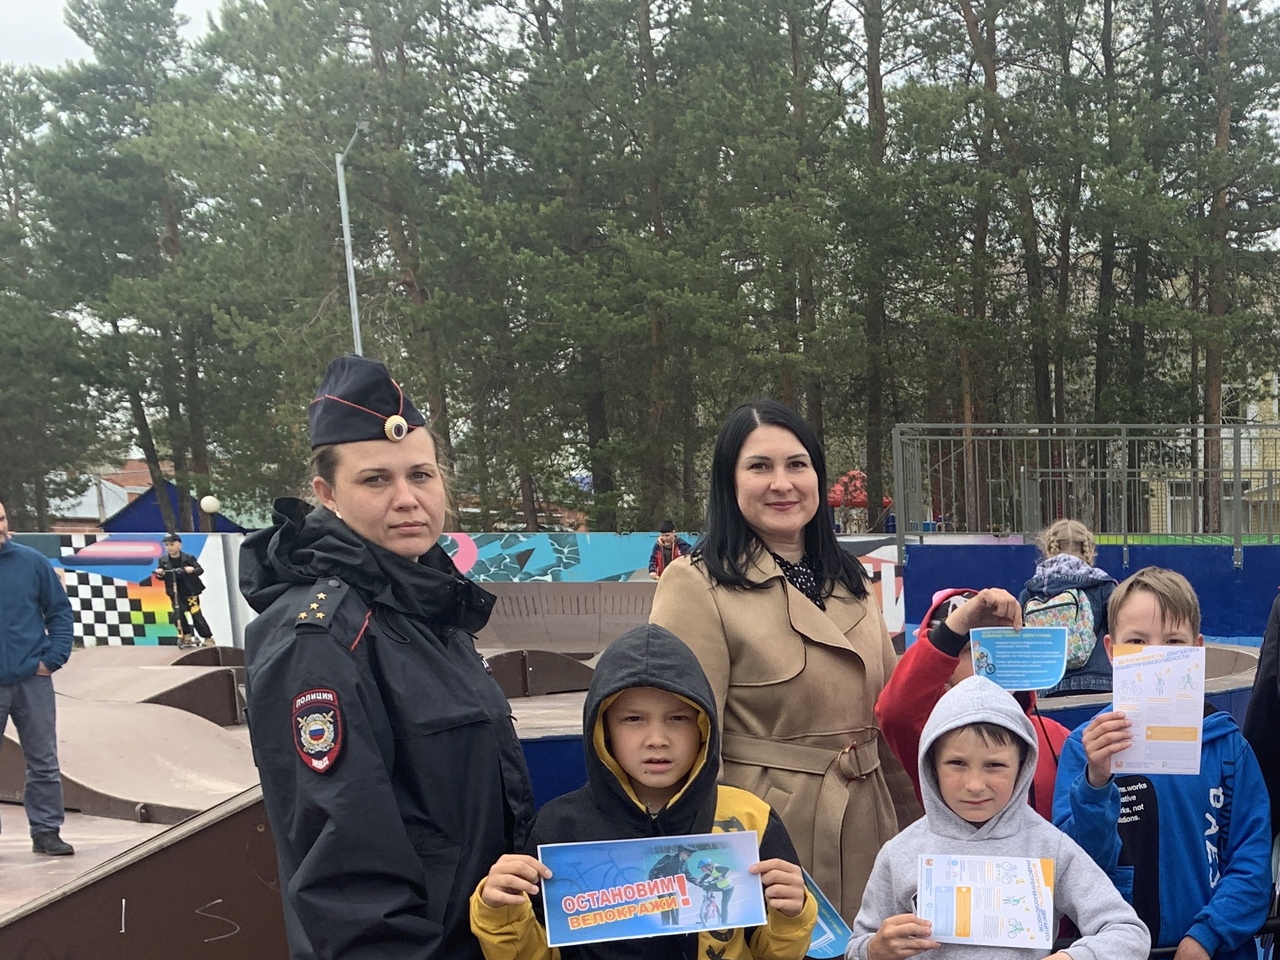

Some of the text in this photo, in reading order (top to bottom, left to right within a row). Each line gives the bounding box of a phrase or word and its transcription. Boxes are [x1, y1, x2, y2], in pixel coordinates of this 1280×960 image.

[295, 692, 334, 708] ПОЛИЦИЯ
[562, 876, 675, 914] ОСТАНОВИМ
[568, 896, 680, 931] ВЕЛОКРАЖИ
